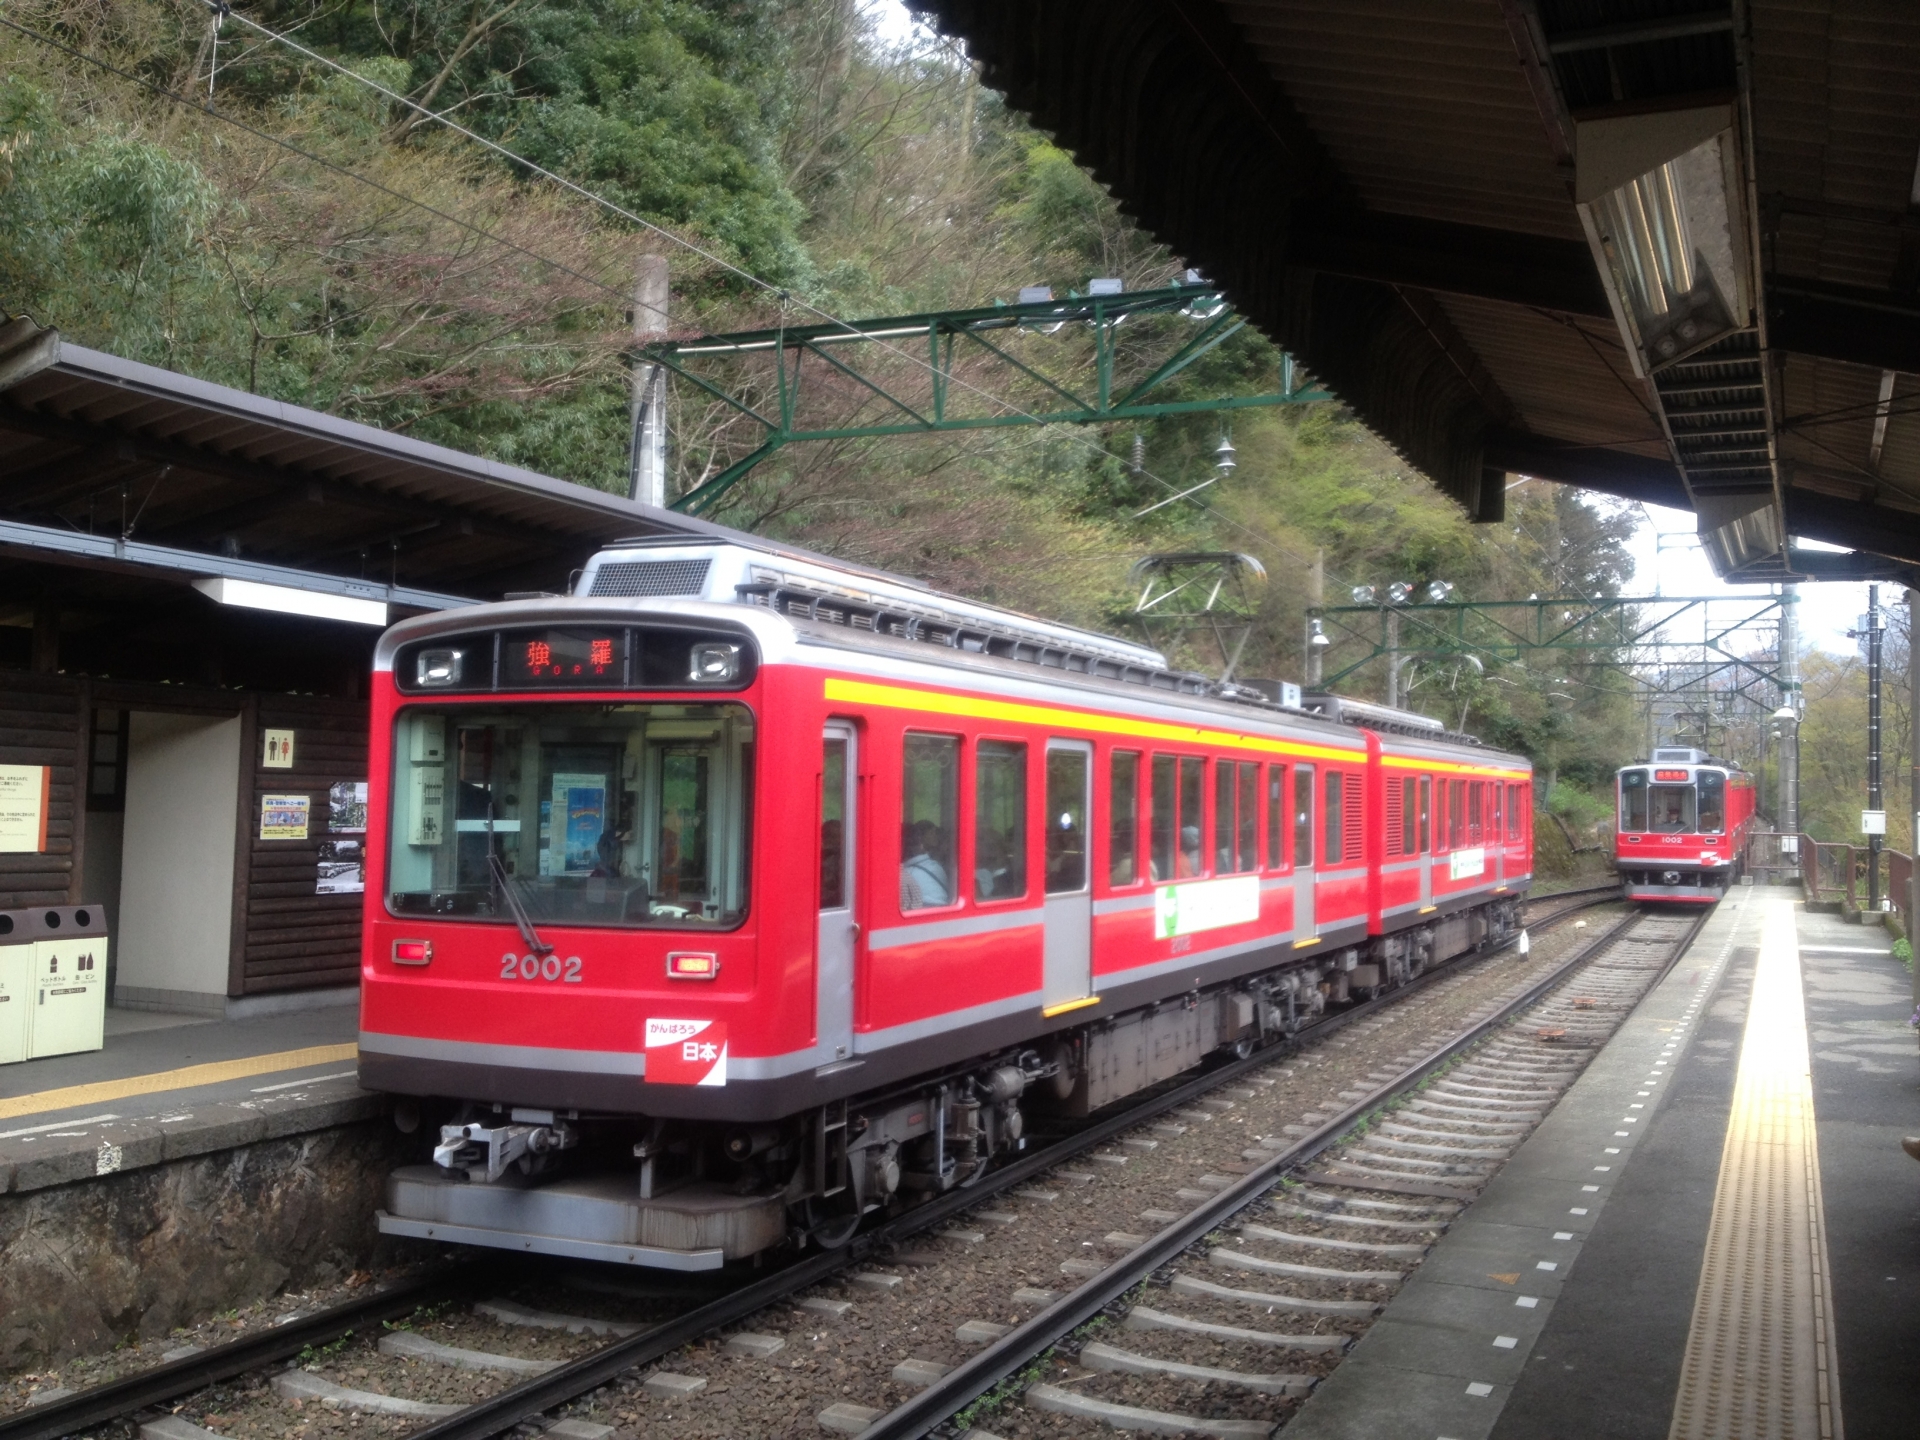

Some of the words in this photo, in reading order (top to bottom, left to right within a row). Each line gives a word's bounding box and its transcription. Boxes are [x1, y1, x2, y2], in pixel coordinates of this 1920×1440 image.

[528, 640, 612, 666] 強羅
[501, 953, 582, 983] 2002
[650, 1024, 696, 1034] がんばろう
[683, 1042, 718, 1062] 日本
